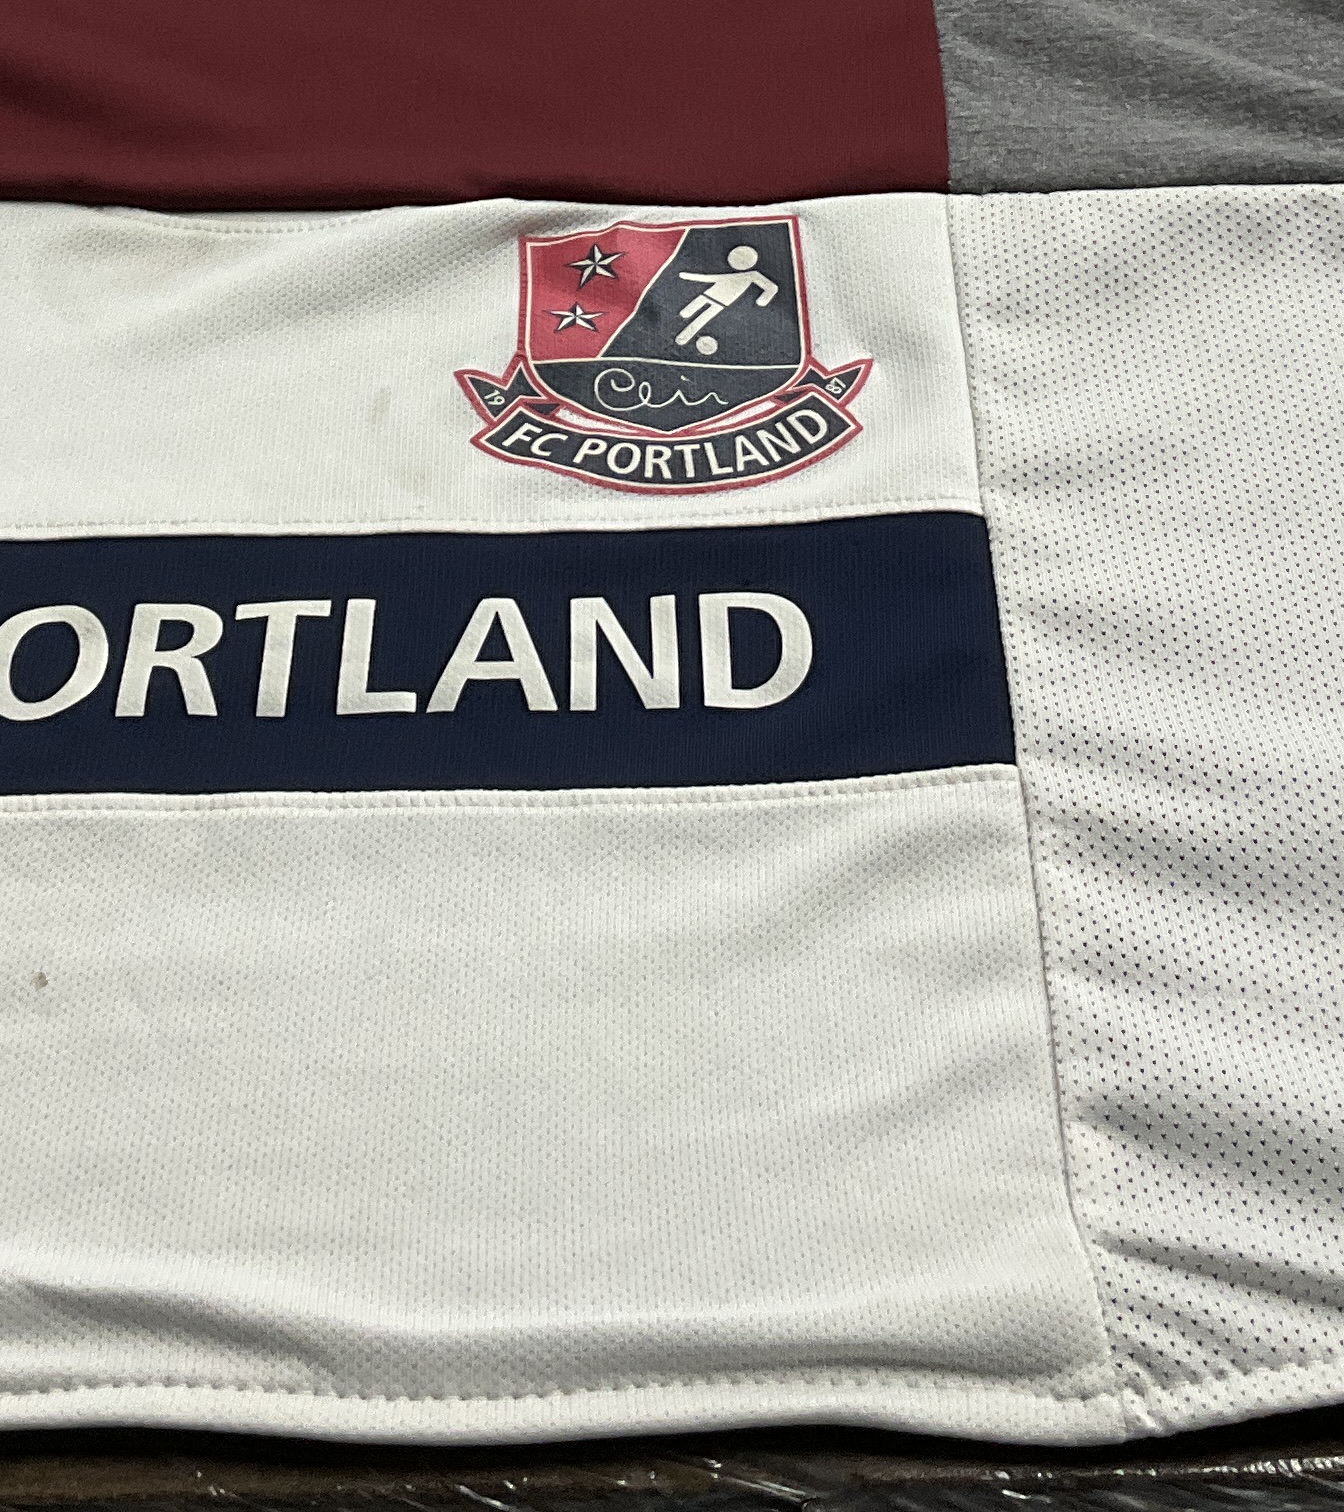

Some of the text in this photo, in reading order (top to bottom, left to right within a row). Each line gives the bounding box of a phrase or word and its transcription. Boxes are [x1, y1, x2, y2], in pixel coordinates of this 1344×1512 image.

[825, 376, 849, 396] 87
[484, 388, 507, 408] 19
[502, 408, 829, 479] FC PORTLAND
